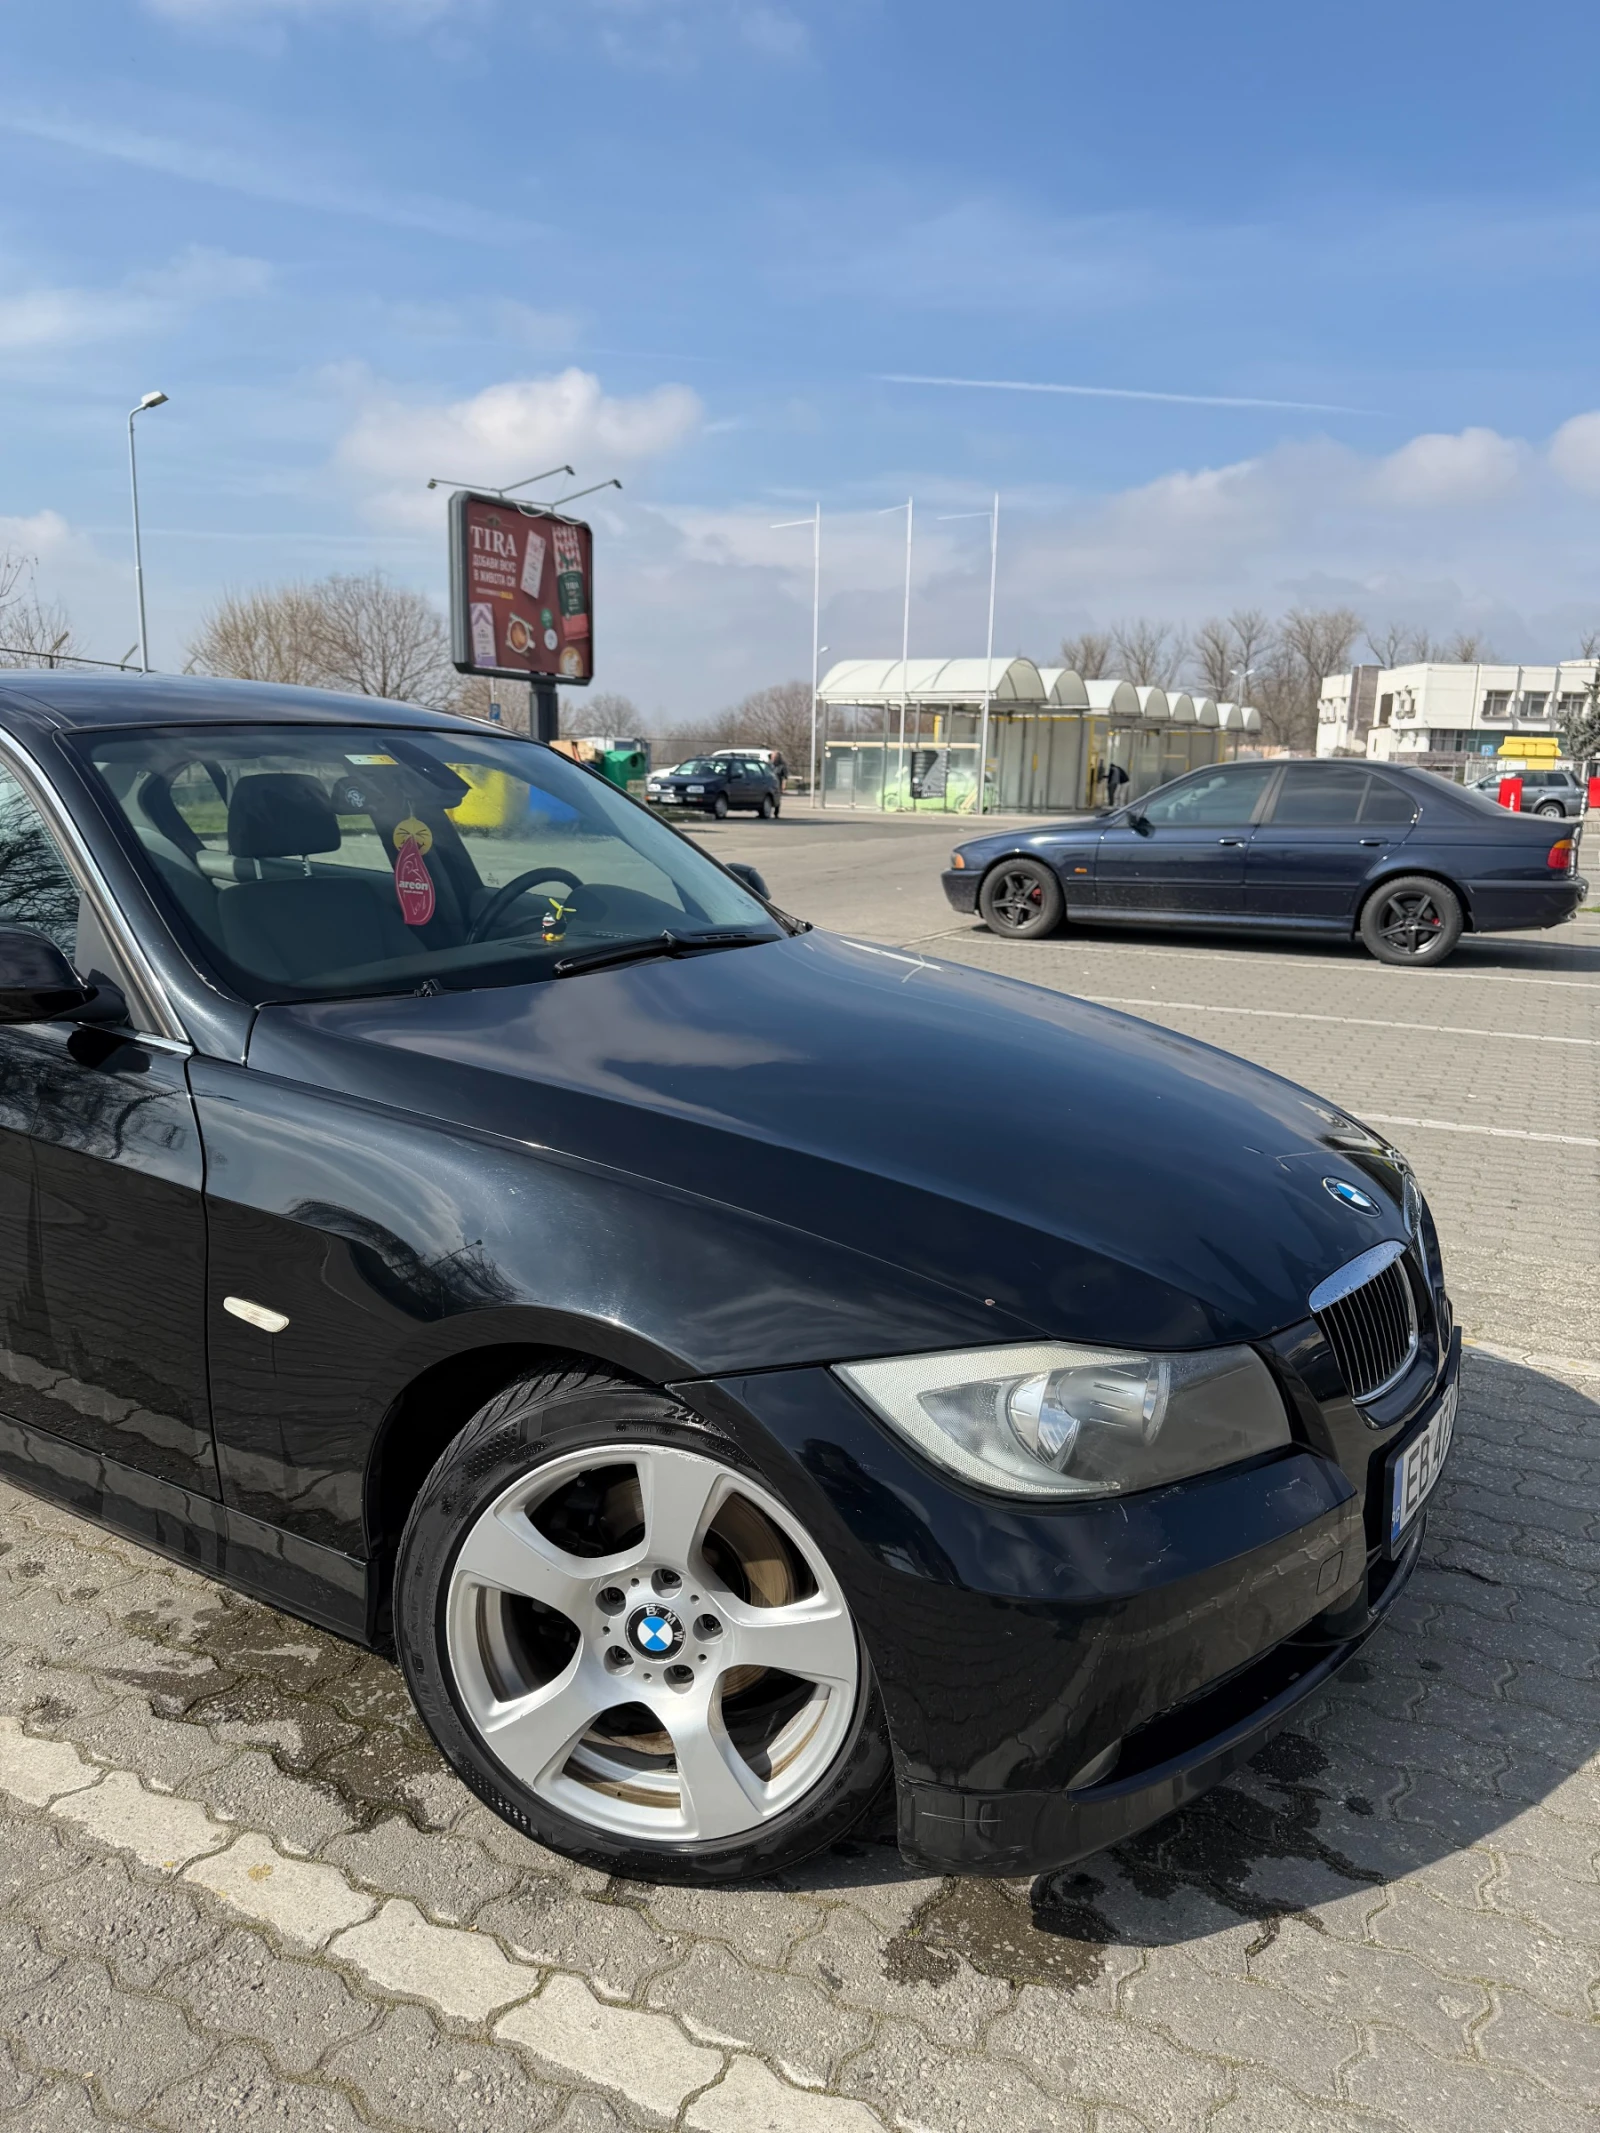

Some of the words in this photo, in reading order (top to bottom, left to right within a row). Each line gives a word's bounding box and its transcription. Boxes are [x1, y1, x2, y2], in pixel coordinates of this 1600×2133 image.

[470, 525, 518, 558] TIRA
[398, 880, 428, 890] areon
[646, 1606, 685, 1642] BMW
